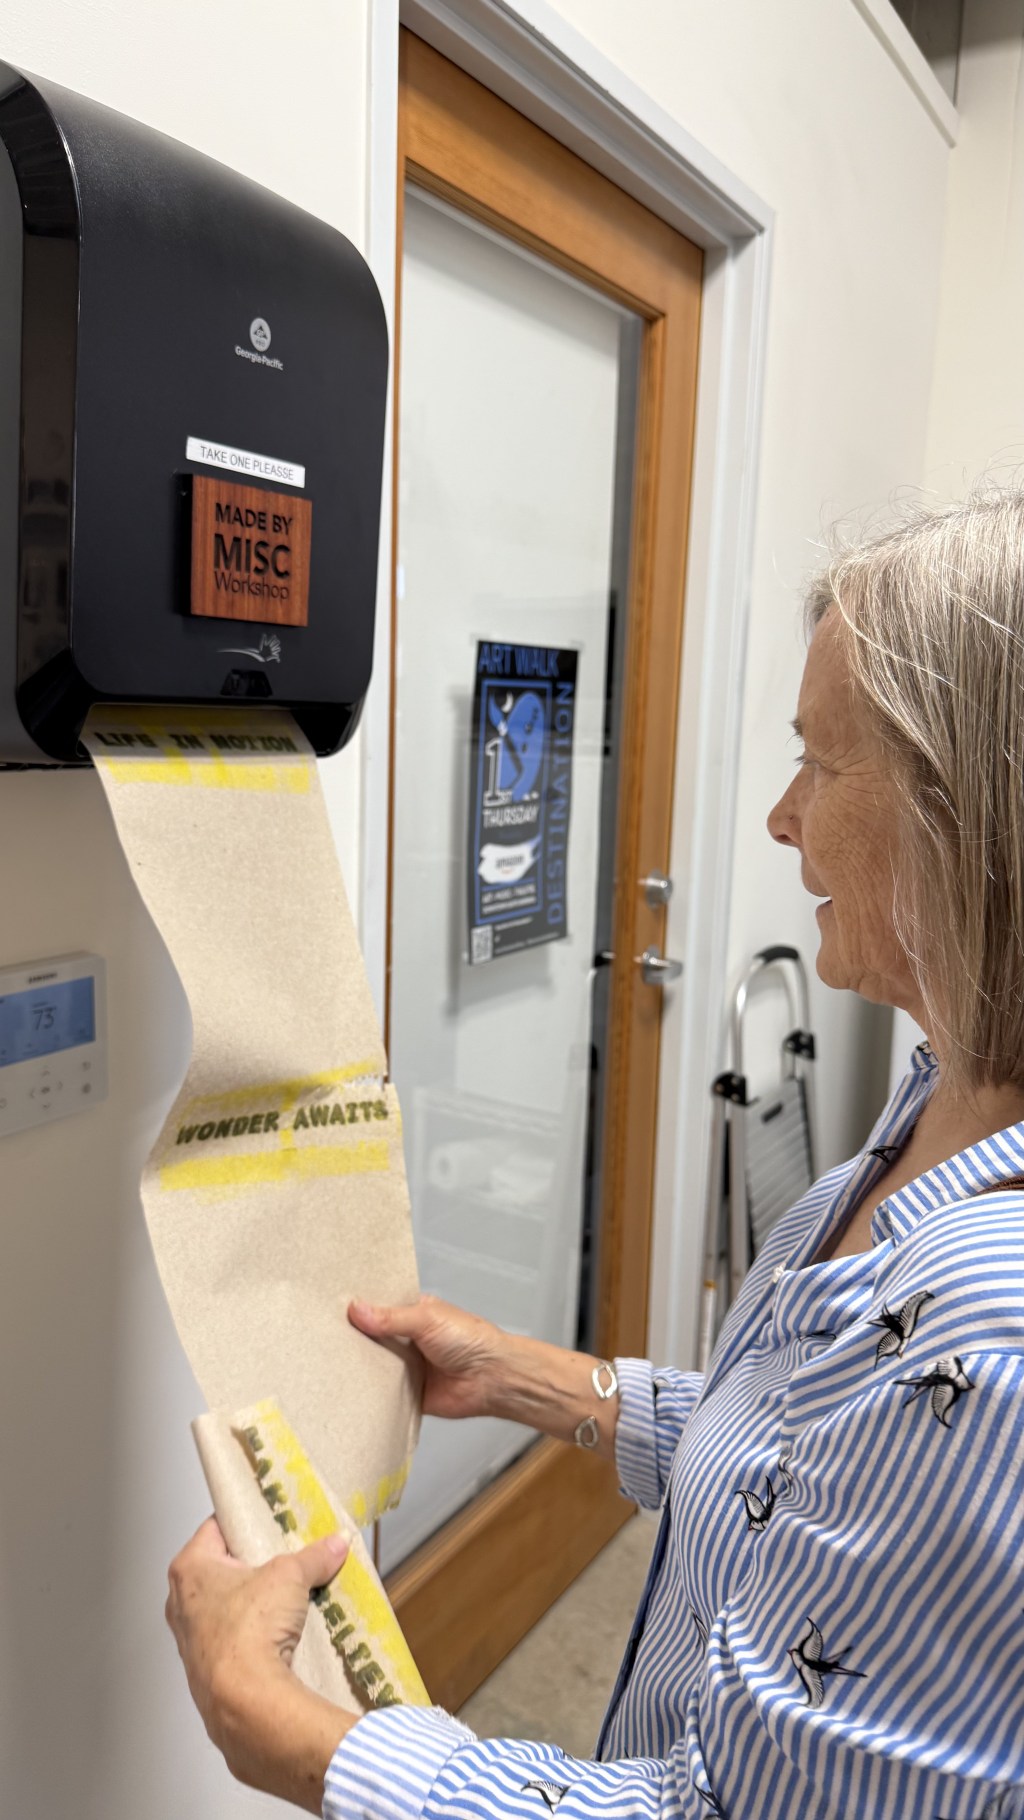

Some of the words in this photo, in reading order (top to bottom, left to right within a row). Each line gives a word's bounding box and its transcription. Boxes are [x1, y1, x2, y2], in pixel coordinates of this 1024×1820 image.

[200, 446, 228, 464] TAKE
[230, 454, 251, 471] ONE
[253, 459, 294, 481] PLEASSE
[215, 503, 267, 531] MADE
[272, 512, 293, 535] BY
[213, 533, 291, 578] MISC
[214, 571, 290, 600] Workshop
[479, 643, 512, 675] ART
[514, 647, 560, 677] WALK
[95, 731, 158, 748] LIFE
[168, 733, 204, 749] IN
[209, 735, 298, 752] MOTION
[482, 805, 540, 829] THURSDAY
[546, 681, 574, 924] DESTINATION
[175, 1111, 280, 1145] WONDER
[293, 1100, 389, 1130] AWAITS
[309, 1586, 402, 1708] ELIEV
